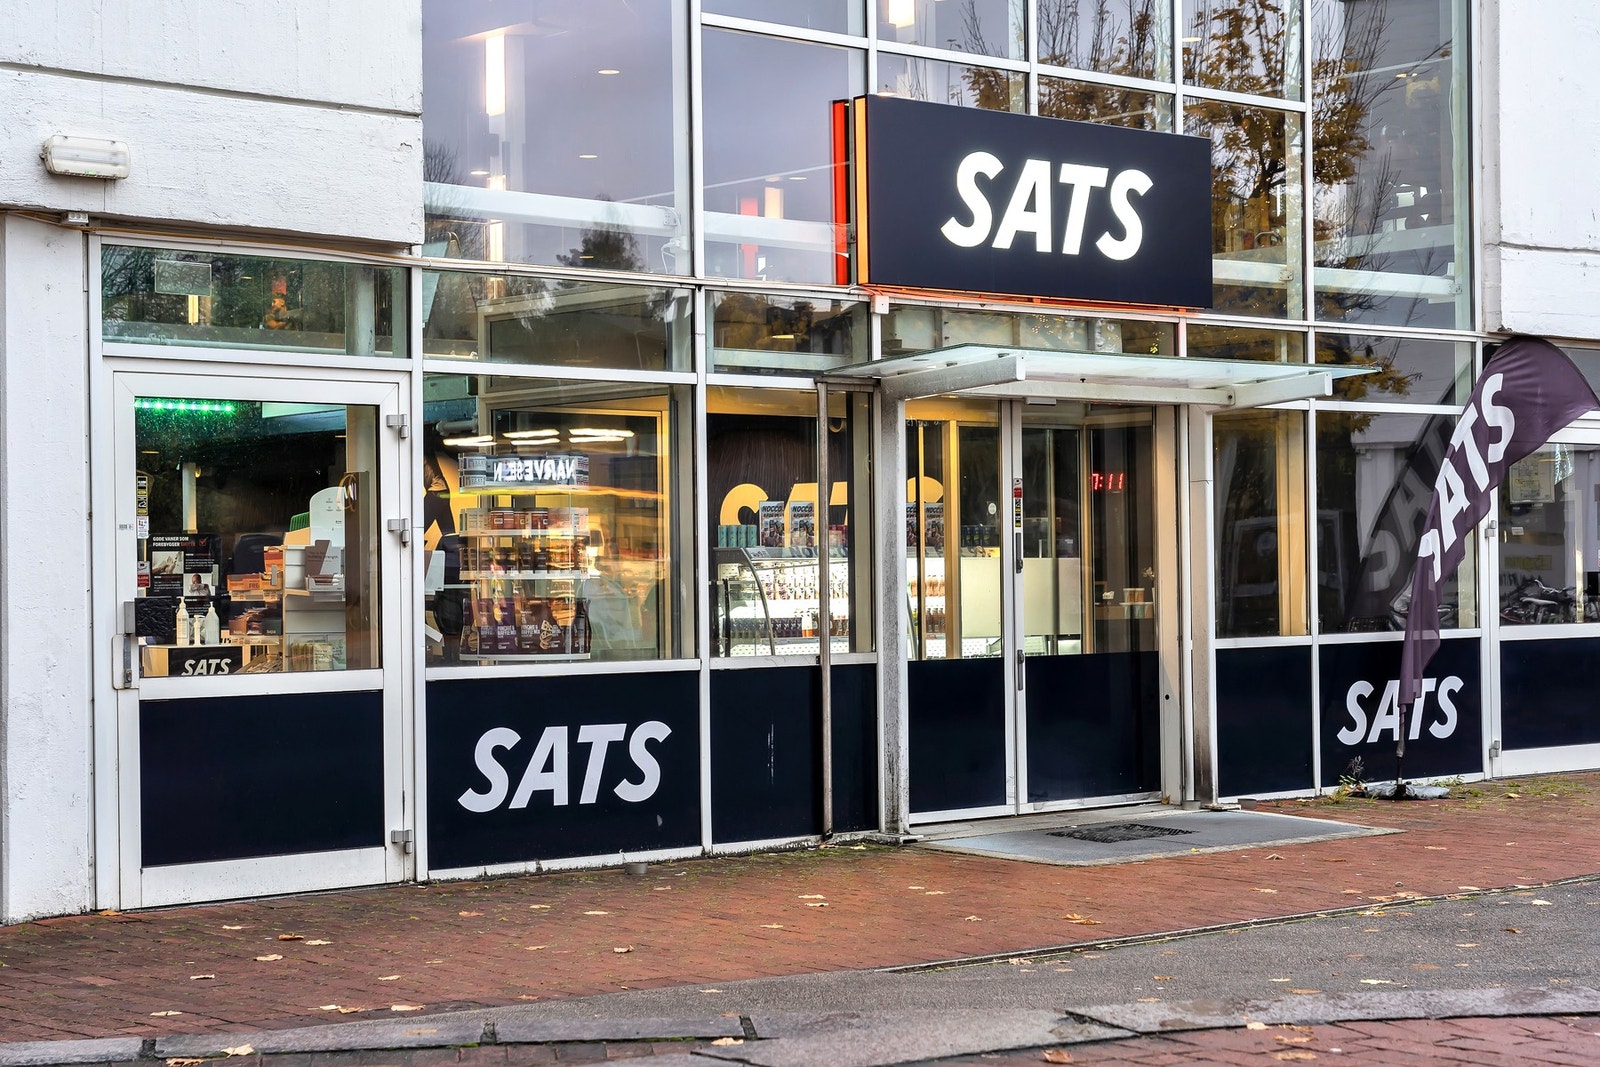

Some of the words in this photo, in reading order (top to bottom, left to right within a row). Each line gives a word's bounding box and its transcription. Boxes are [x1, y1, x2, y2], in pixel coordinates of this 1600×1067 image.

[940, 150, 1154, 261] SATS
[181, 658, 232, 676] SATS
[1336, 675, 1465, 746] SATS
[457, 720, 673, 813] SATS
